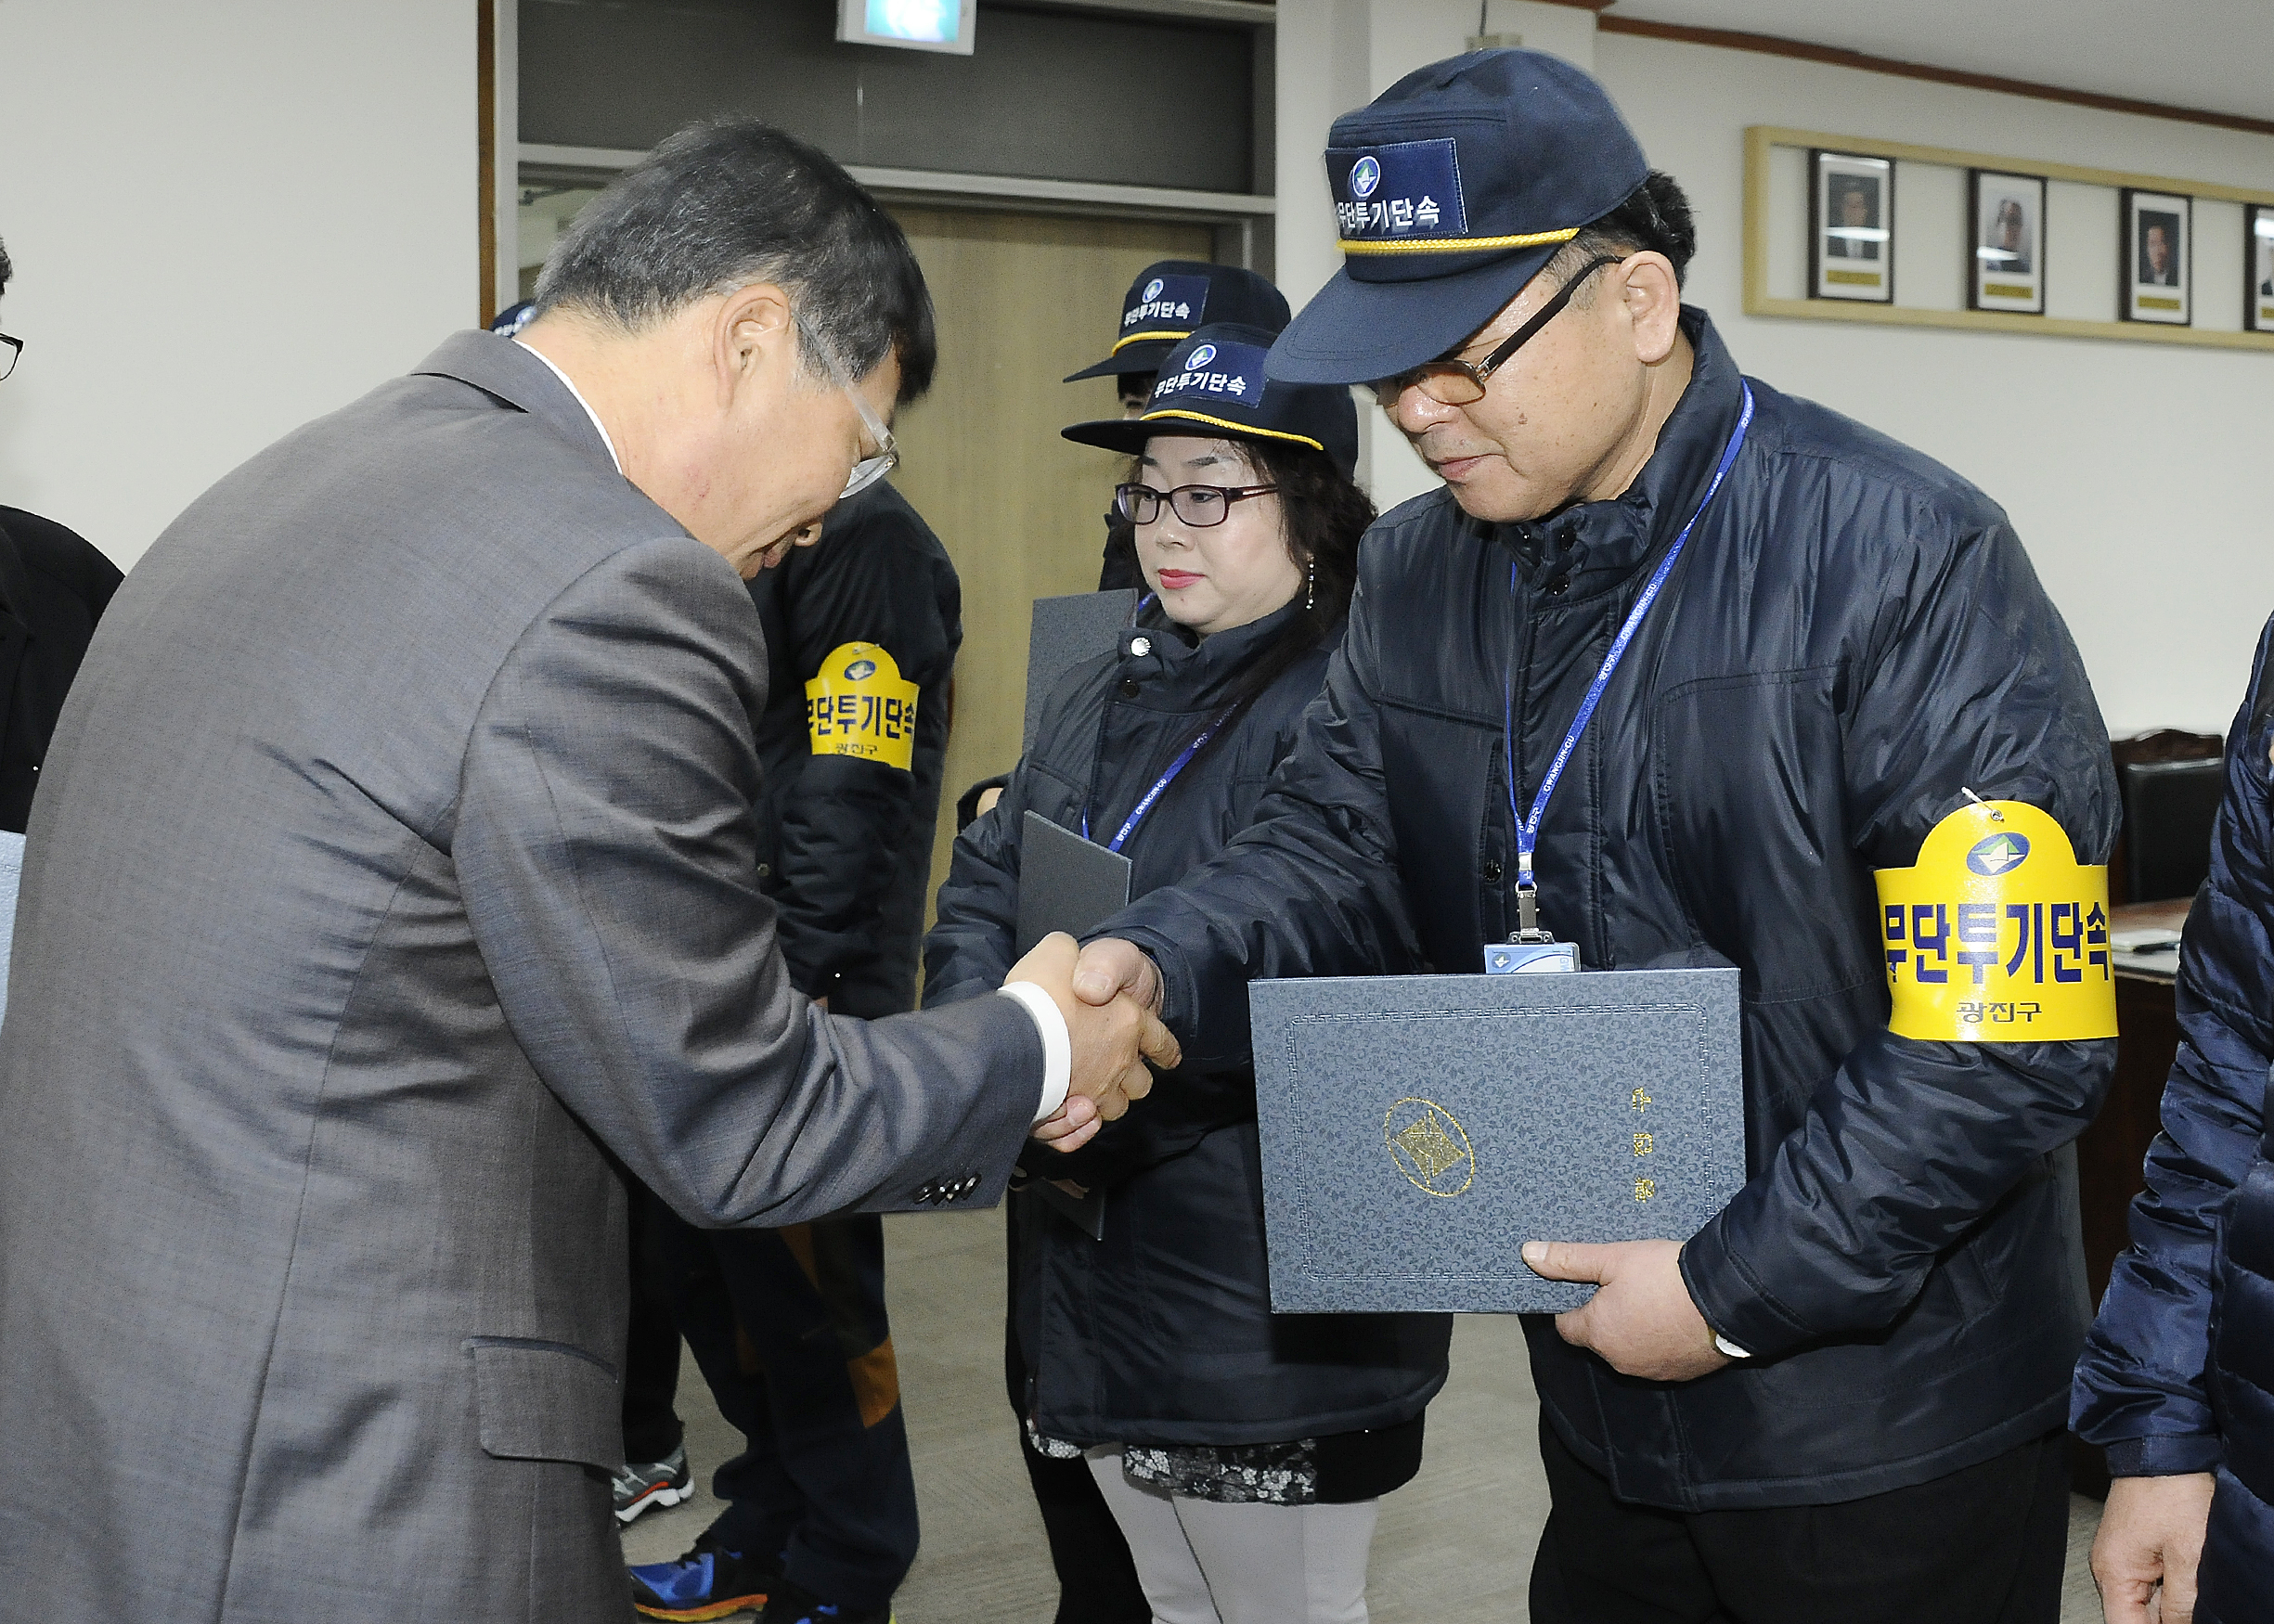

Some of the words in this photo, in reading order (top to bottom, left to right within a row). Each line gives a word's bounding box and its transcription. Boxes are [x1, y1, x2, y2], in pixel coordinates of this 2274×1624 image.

[1154, 371, 1247, 398] 무단투기단속
[835, 742, 878, 755] 광진구
[1884, 901, 2111, 984] 무단투기단속
[1956, 1001, 2043, 1023] 광진구
